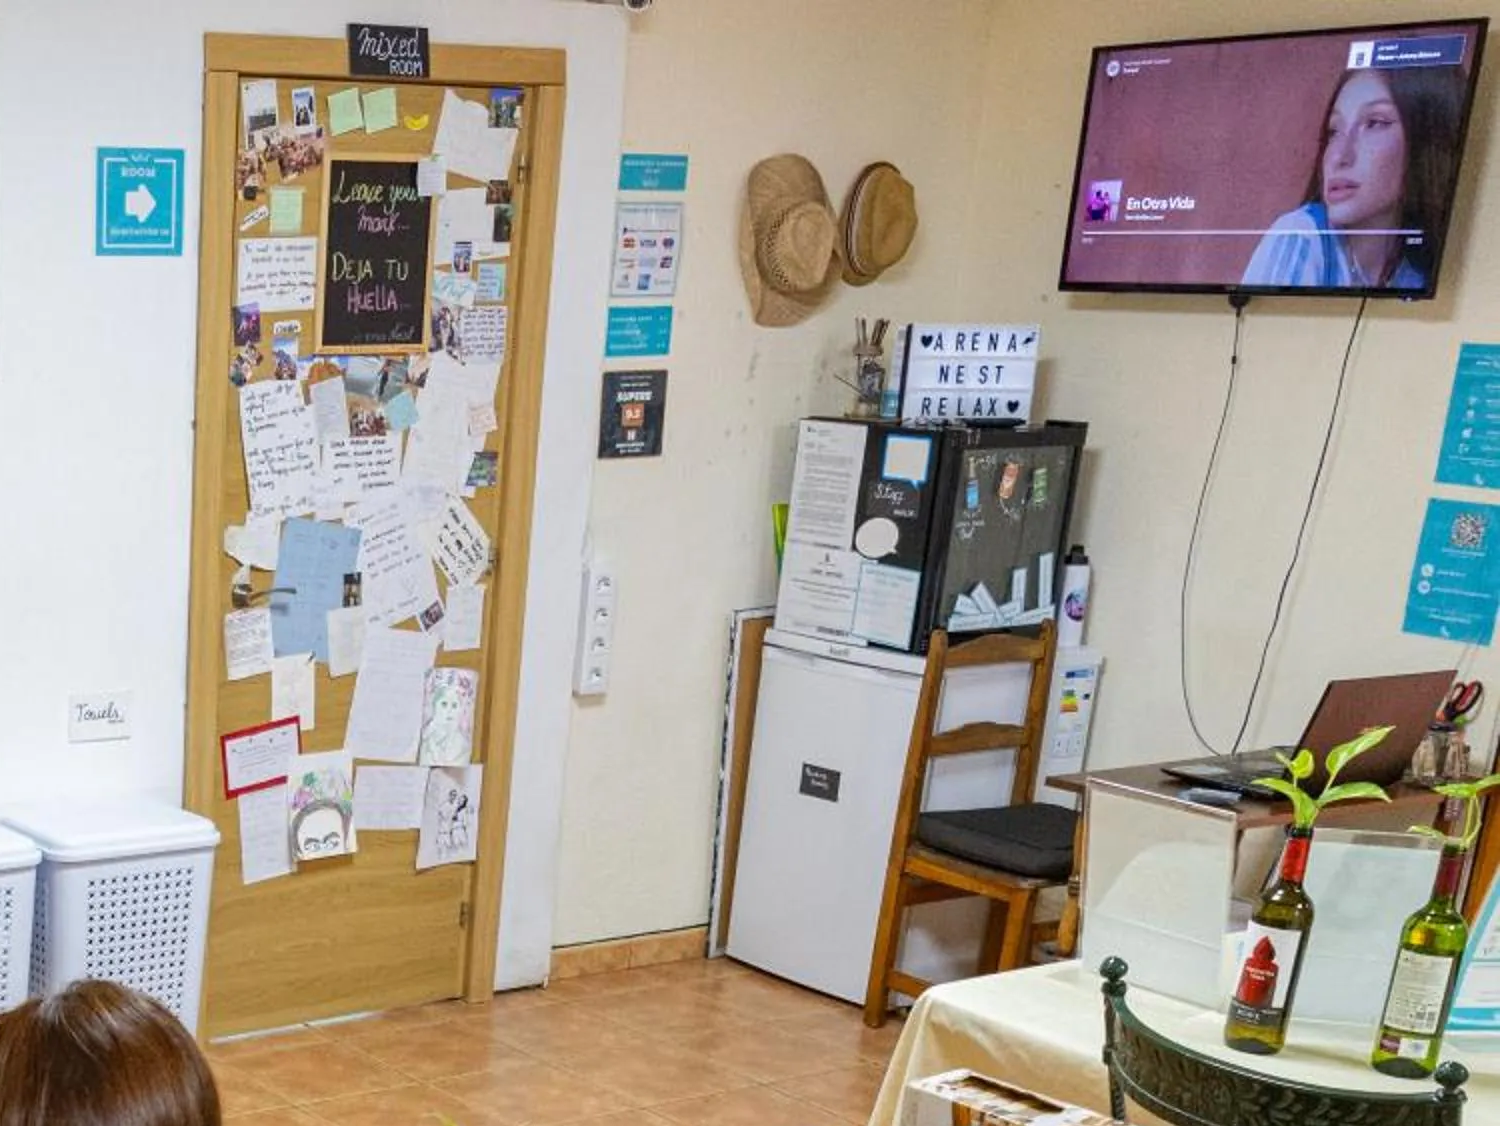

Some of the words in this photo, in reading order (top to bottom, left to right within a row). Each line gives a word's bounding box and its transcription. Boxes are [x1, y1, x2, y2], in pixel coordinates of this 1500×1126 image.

[389, 59, 424, 77] ROOM
[121, 165, 156, 178] ROOM
[333, 170, 384, 205] Leave
[1126, 197, 1141, 210] En
[1141, 197, 1169, 211] Otra
[1169, 196, 1195, 210] Vida
[386, 258, 410, 282] TU
[934, 332, 1019, 353] ARENA
[938, 364, 1005, 385] NEST
[921, 397, 998, 417] RELAX
[76, 701, 124, 724] Towels
